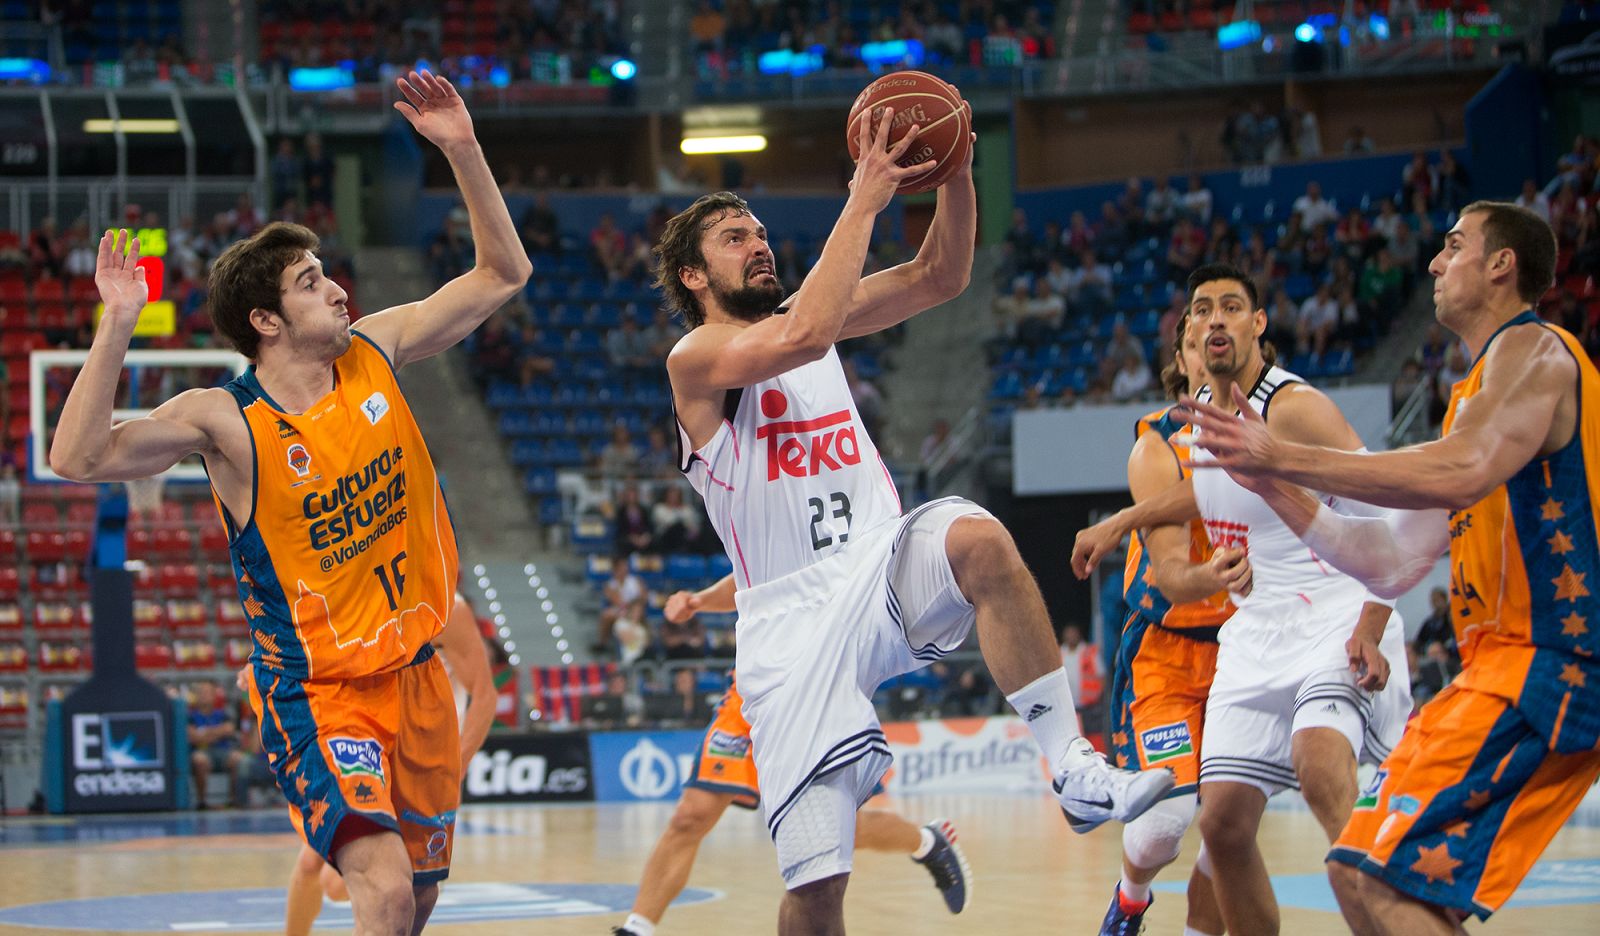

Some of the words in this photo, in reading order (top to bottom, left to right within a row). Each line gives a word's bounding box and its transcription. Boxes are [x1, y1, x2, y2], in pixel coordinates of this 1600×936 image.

[756, 409, 861, 482] Teka
[303, 449, 392, 520] Cultura
[393, 446, 403, 465] de
[320, 506, 407, 573] @ValenciaBas
[808, 491, 853, 551] 23
[74, 769, 165, 796] endesa
[902, 740, 1037, 786] Bifrutas
